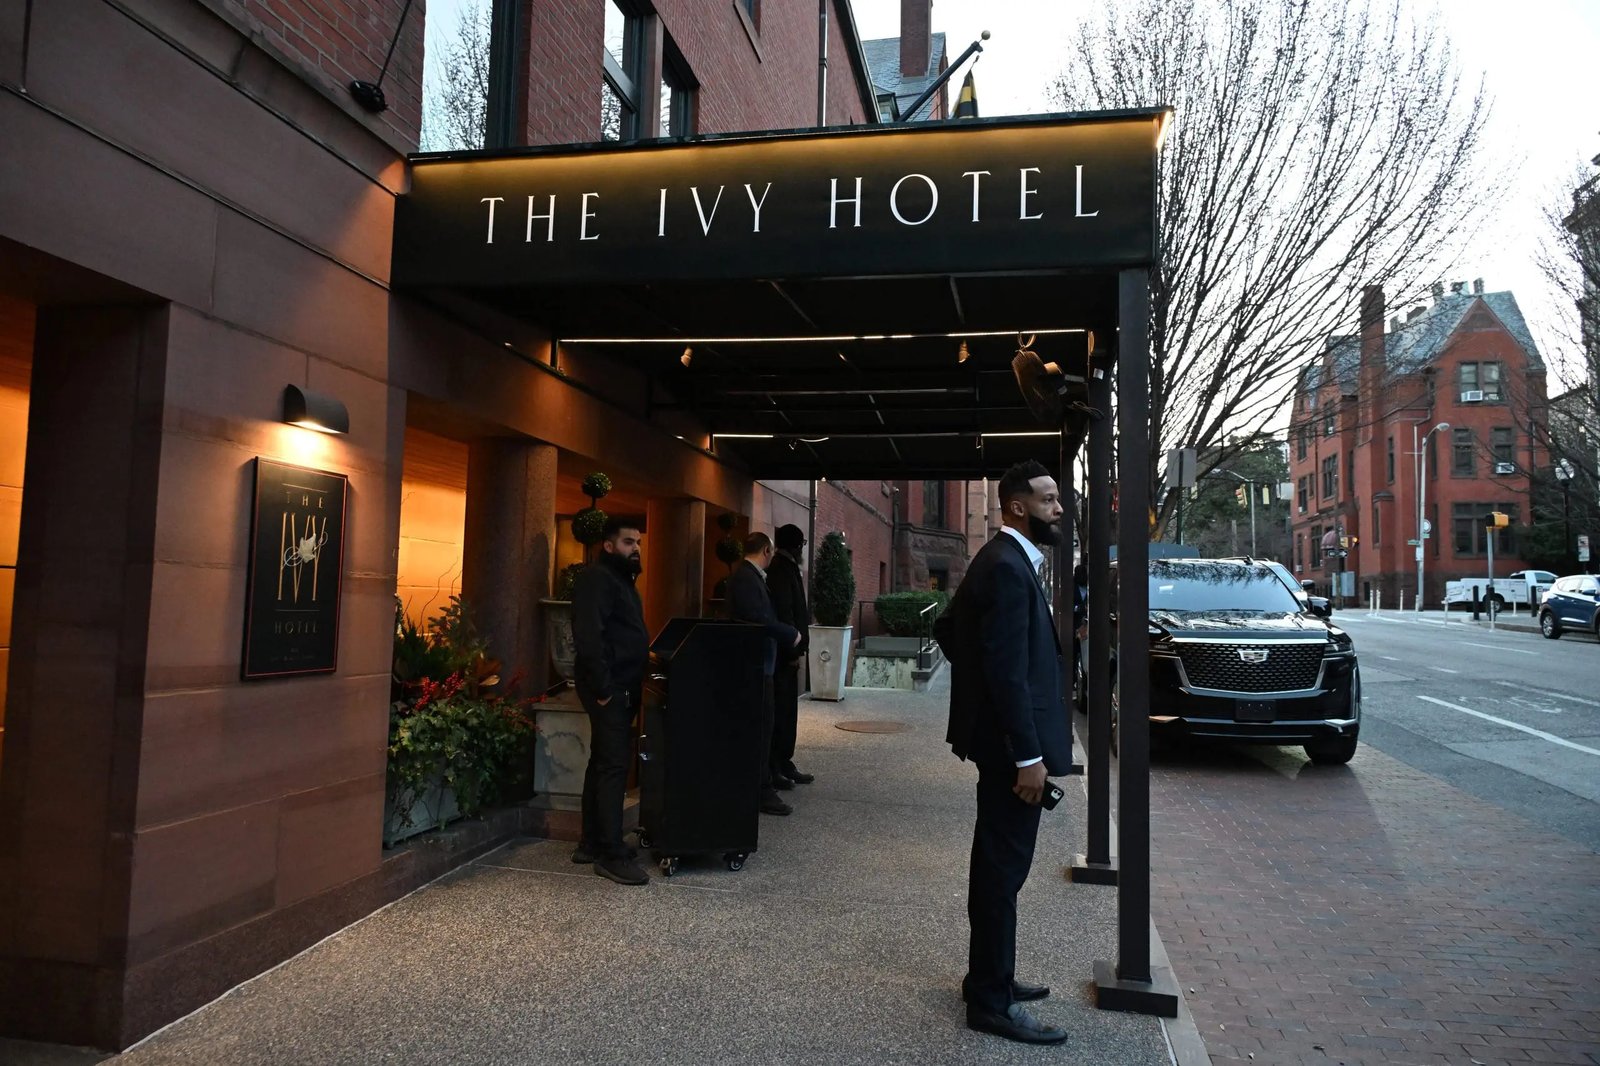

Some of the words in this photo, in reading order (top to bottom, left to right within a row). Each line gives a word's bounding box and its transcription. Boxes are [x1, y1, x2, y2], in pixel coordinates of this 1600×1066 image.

[480, 192, 601, 244] THE
[658, 182, 774, 237] IVY
[829, 164, 1100, 229] HOTEL
[285, 491, 325, 510] THE
[277, 511, 328, 605] IVY
